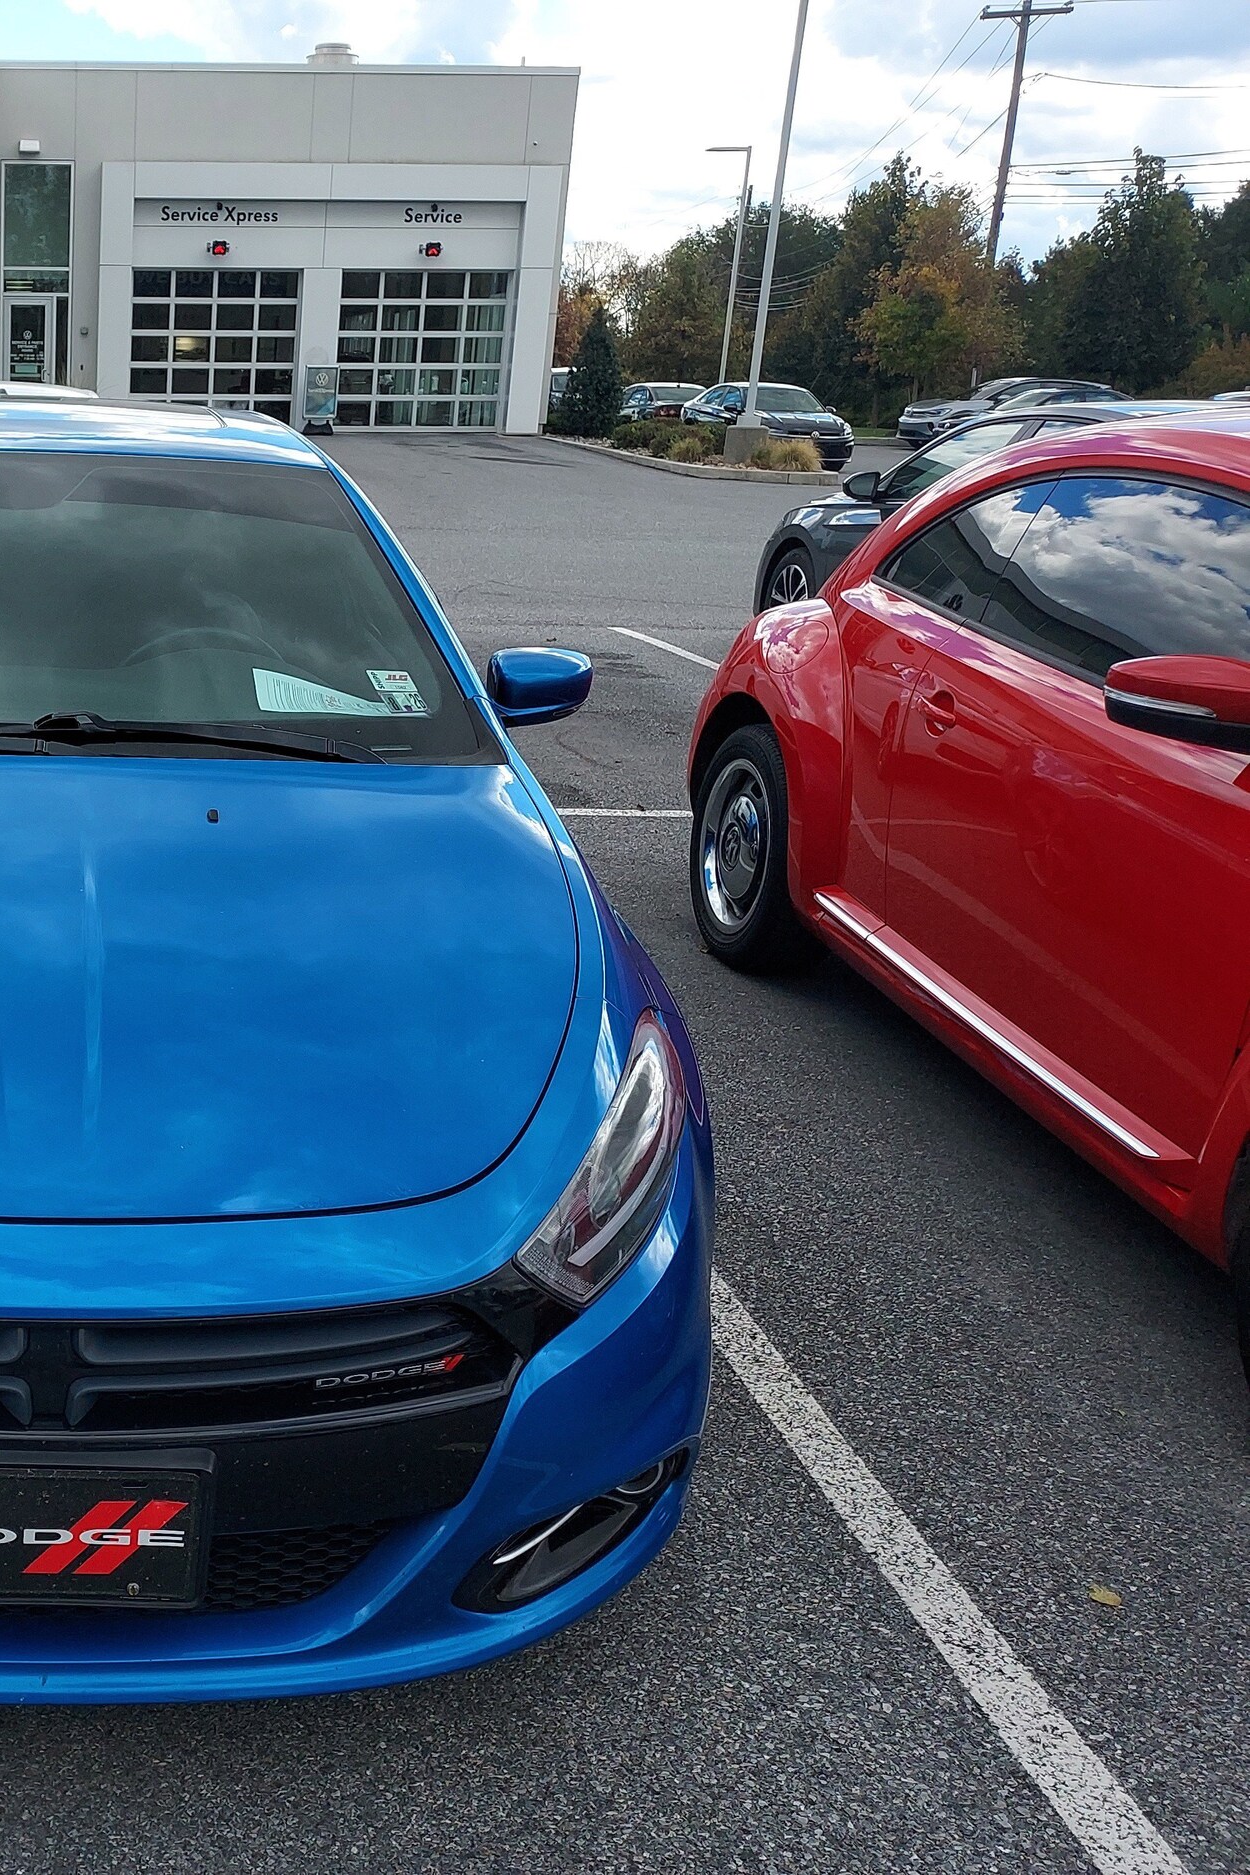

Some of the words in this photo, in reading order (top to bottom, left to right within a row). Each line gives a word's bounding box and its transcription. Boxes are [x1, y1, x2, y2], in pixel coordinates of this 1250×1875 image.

[161, 206, 219, 222] Service
[224, 206, 279, 225] Xpress
[404, 207, 463, 224] Service
[409, 693, 427, 710] 26
[316, 1359, 447, 1388] DODGE
